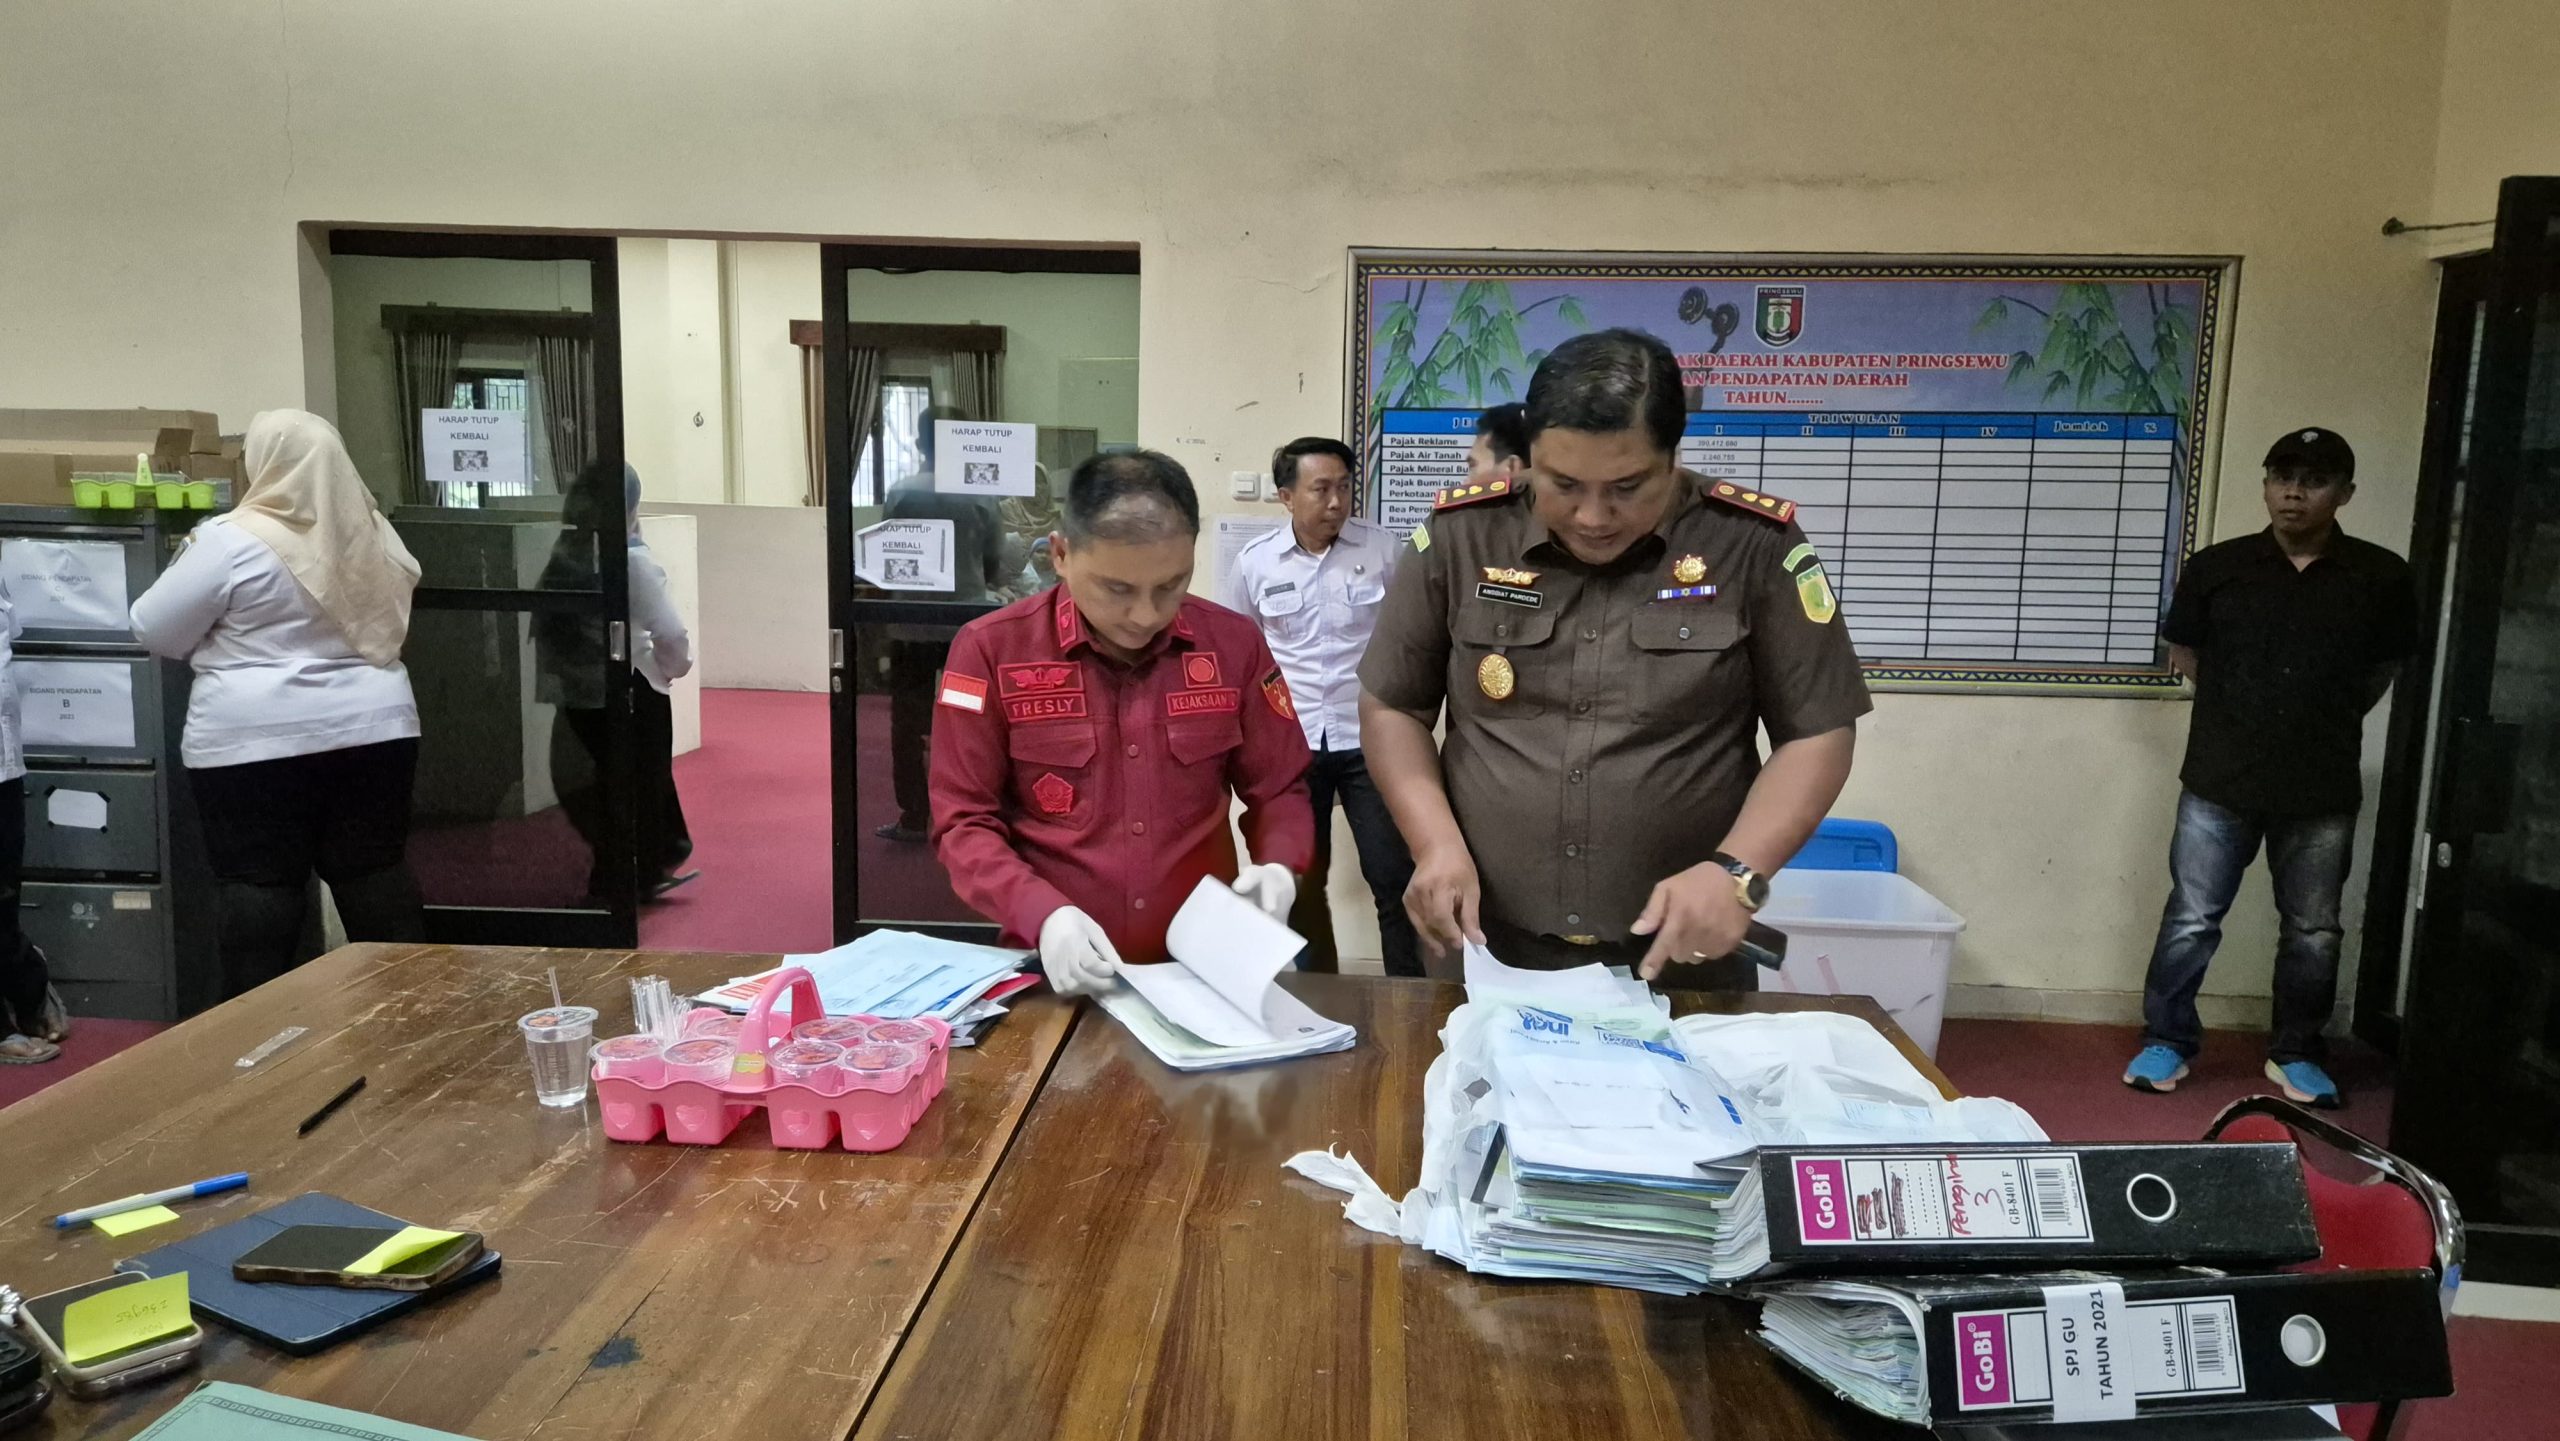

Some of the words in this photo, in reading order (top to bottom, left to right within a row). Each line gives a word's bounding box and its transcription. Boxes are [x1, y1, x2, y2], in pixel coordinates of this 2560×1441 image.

[1704, 354, 1778, 368] DAERAH
[1782, 354, 1892, 368] KABUPATEN
[1895, 354, 2009, 369] PRINGSEWU
[1681, 372, 1704, 386] AN
[1709, 372, 1829, 387] PENDAPATAN
[1831, 372, 1909, 387] DAERAH
[438, 416, 469, 424] HARAP
[471, 416, 500, 424] TUTUP
[1808, 413, 1900, 425] TRIWULAN
[2053, 420, 2109, 433] Jumlah
[450, 432, 489, 441] KEMBALI
[950, 427, 982, 437] HARAP
[984, 429, 1013, 437] TUTUP
[1390, 437, 1416, 448] Pajak
[1417, 437, 1458, 445] Reklame
[962, 444, 1002, 453] KEMBALI
[1390, 451, 1415, 461] Pajak
[1418, 451, 1432, 459] Air
[1433, 451, 1462, 459] Tanah
[1389, 465, 1415, 475] Pajak
[1417, 465, 1454, 473] Mineral
[1456, 465, 1469, 473] Bu
[1389, 479, 1415, 488] Pajak
[1417, 479, 1442, 487] Bumi
[1443, 479, 1461, 487] dan
[1389, 490, 1437, 499] Perkotaan
[1389, 505, 1407, 513] Bea
[1408, 505, 1432, 513] Perol
[1388, 516, 1424, 525] Bangun
[878, 524, 901, 534] ARAP
[903, 525, 931, 534] TUTUP
[882, 541, 921, 549] KEMBALI
[62, 699, 71, 708] B
[2002, 1170, 2013, 1179] F
[1811, 1172, 1836, 1230] GoBi
[1974, 1187, 2006, 1214] 3
[2003, 1180, 2021, 1226] GB-8401
[2091, 1289, 2107, 1332] 2021
[2160, 1318, 2172, 1326] F
[2062, 1317, 2076, 1343] GU
[2161, 1331, 2177, 1377] GB-8401
[1973, 1330, 1995, 1392] GoBi
[2066, 1349, 2080, 1377] SPJ
[2098, 1336, 2114, 1400] TAHUN
